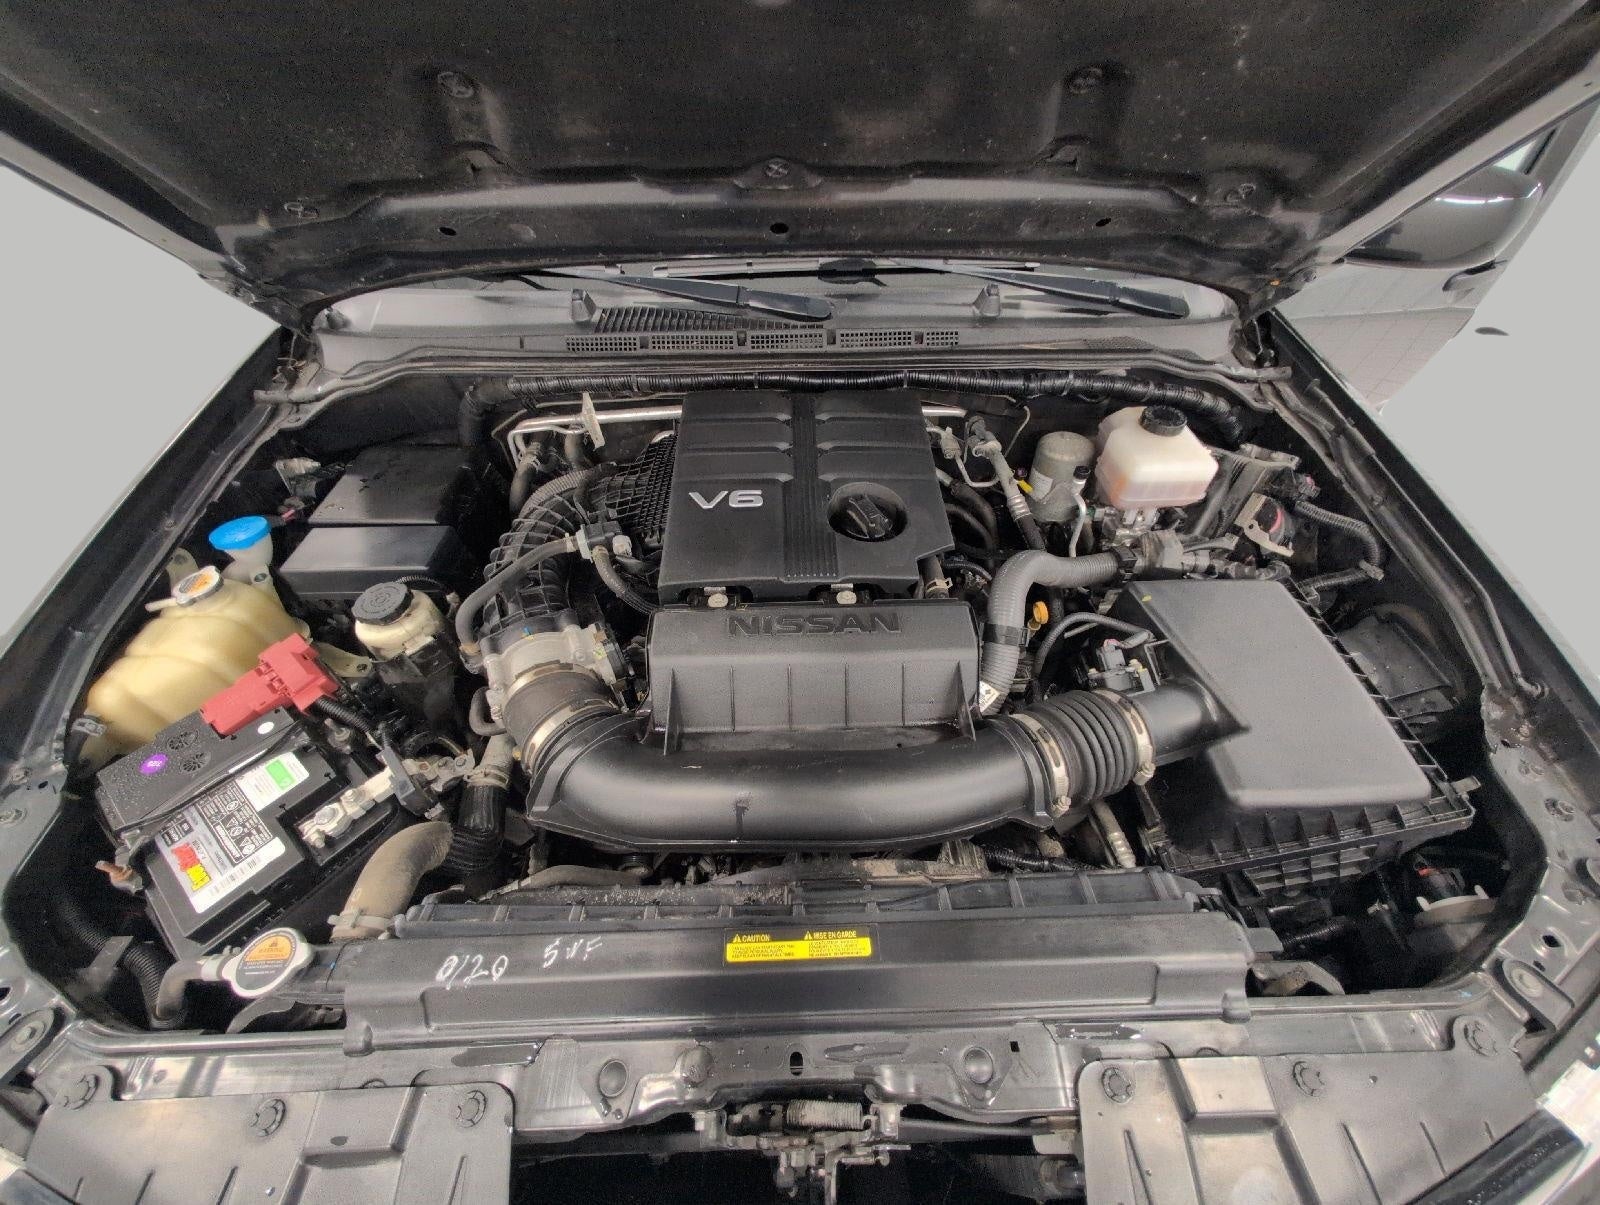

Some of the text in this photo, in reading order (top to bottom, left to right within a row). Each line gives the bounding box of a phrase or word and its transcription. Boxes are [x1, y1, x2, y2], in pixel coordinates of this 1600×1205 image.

[688, 489, 764, 510] V6
[728, 612, 902, 638] NISSAN
[742, 933, 771, 943] CAUTION
[837, 930, 857, 939] GARDE
